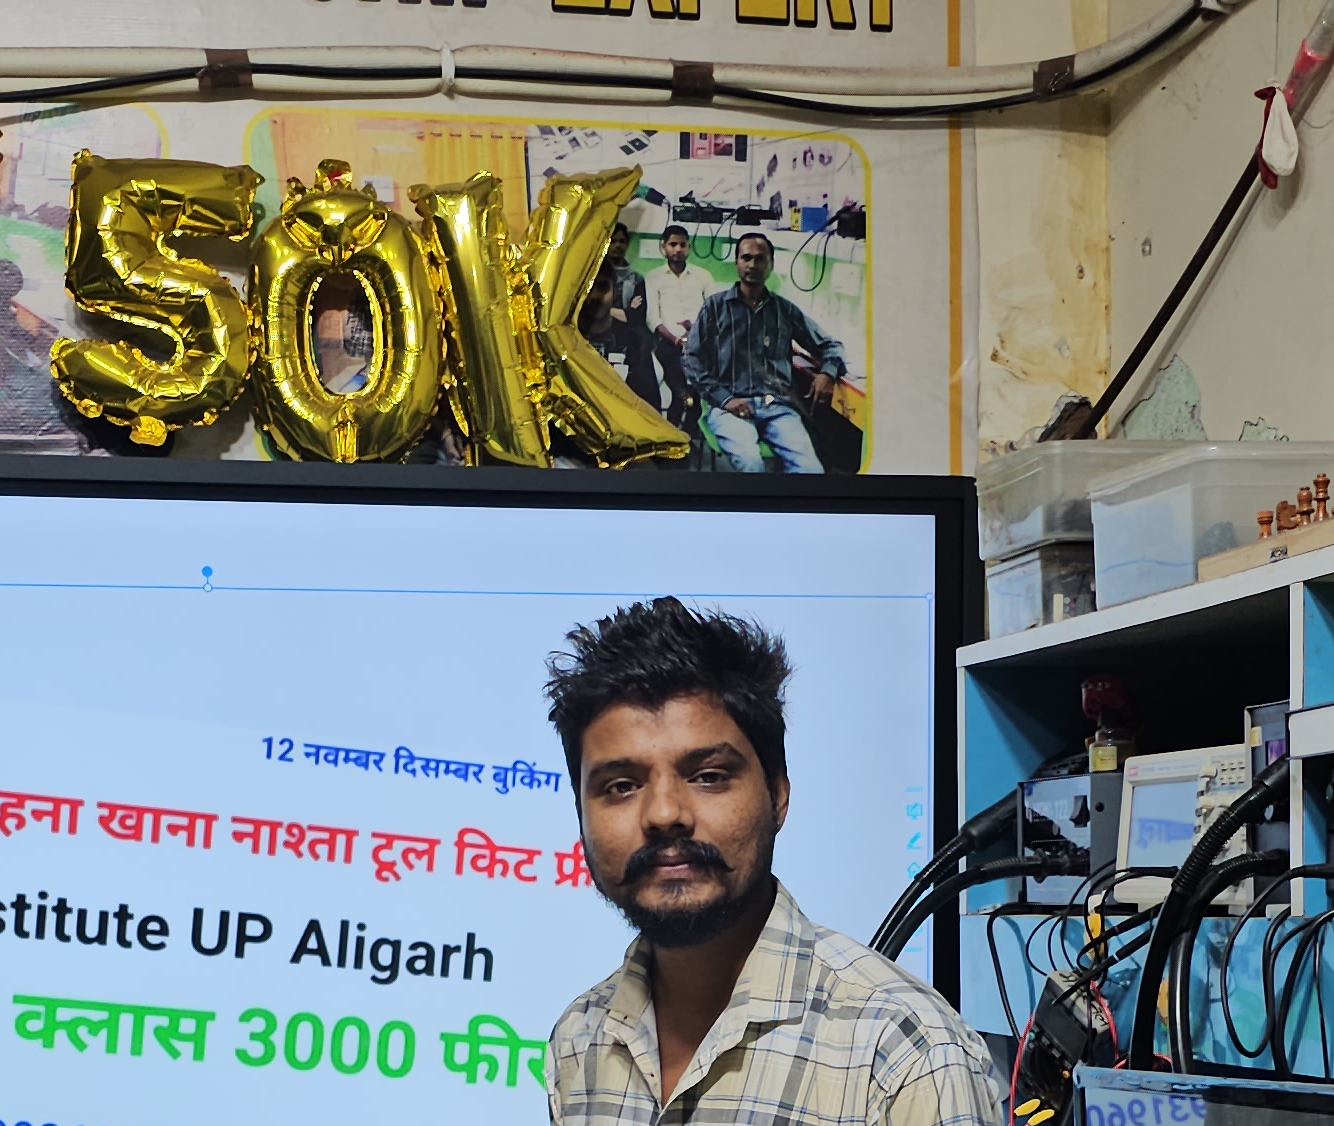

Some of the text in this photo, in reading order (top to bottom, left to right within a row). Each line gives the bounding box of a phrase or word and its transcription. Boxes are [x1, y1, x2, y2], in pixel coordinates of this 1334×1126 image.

[262, 736, 562, 795] 12 नवम्बर दिसम्बर बुकिंग
[98, 801, 219, 851] खाना
[232, 816, 359, 866] नाश्ता
[371, 831, 440, 883] टूल
[454, 828, 543, 884] किट
[189, 906, 273, 960] UP
[289, 918, 496, 985] Aligarh
[12, 993, 216, 1063] क्लास
[234, 1008, 417, 1079] 3000
